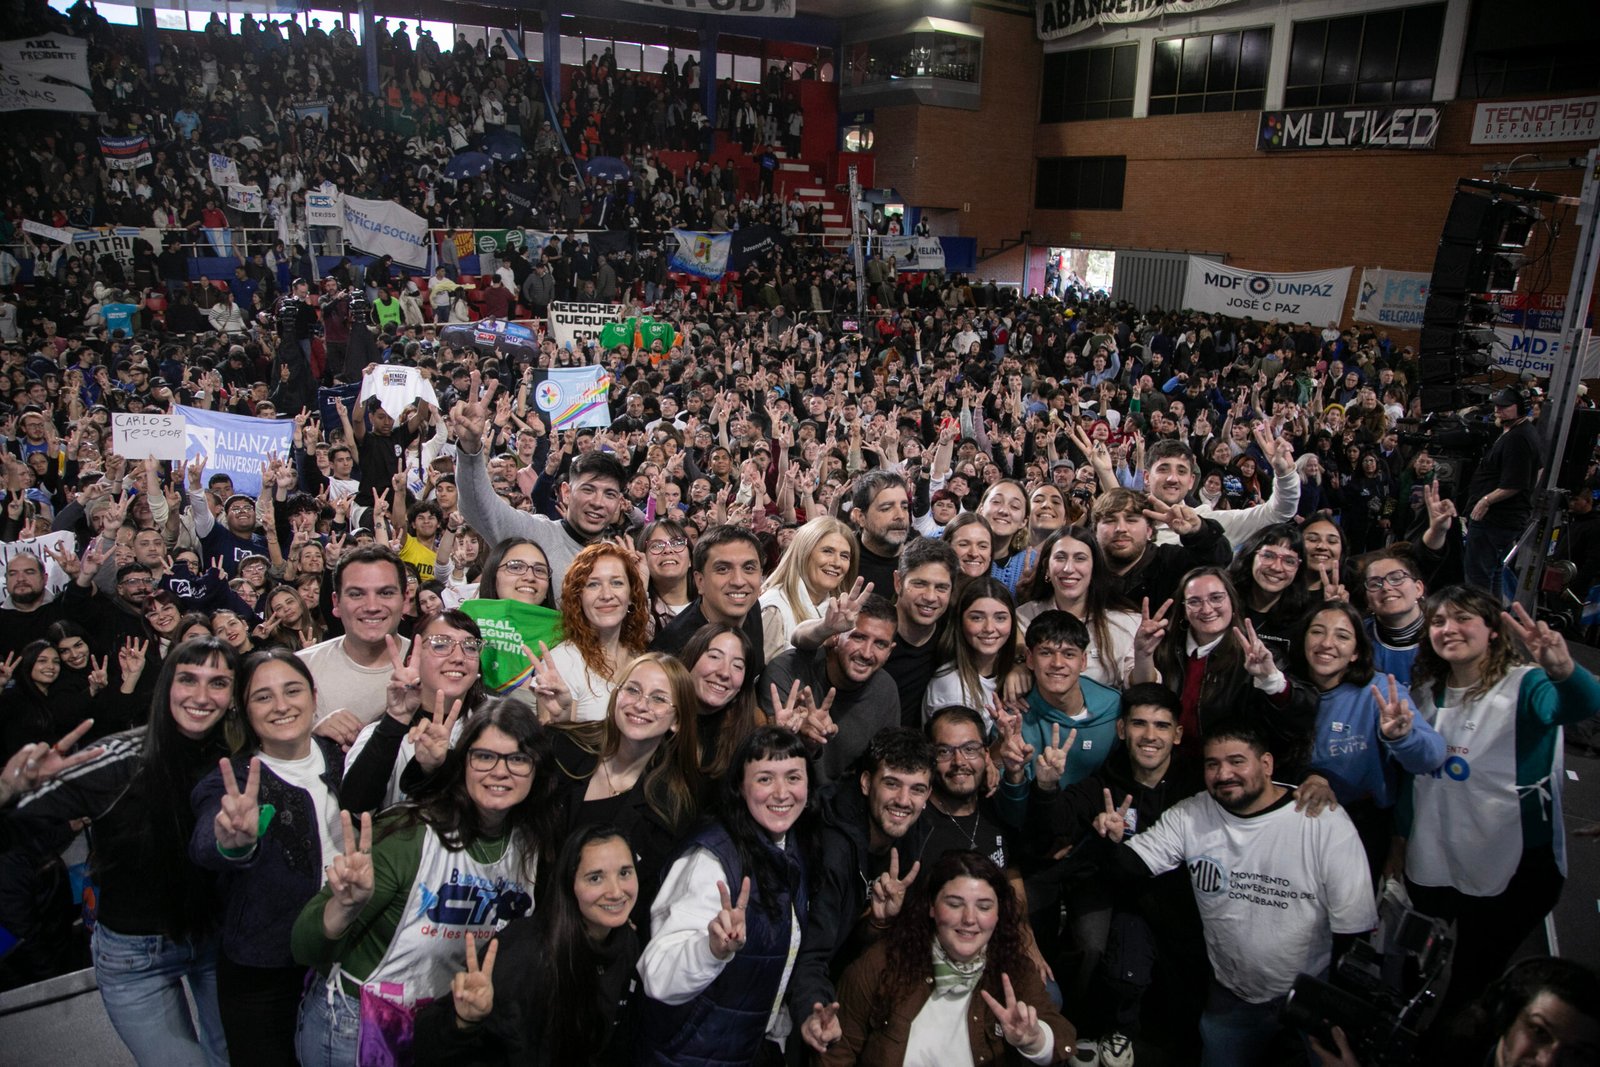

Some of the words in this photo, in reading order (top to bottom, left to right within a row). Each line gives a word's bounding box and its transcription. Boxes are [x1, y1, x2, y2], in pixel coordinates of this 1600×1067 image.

[26, 41, 60, 49] AXEL
[20, 51, 76, 60] PRESIDENTE
[1485, 101, 1598, 123] TECNOPISO
[1282, 107, 1440, 147] MULTILED
[1485, 118, 1594, 133] DEPORTIVO
[101, 229, 115, 237] LA
[383, 226, 424, 246] SOCIAL
[75, 236, 131, 254] PATRI
[1204, 272, 1243, 290] MDF
[1277, 282, 1333, 297] UNPAZ
[551, 303, 622, 314] NECOCHEA
[1227, 297, 1259, 309] JOSÉ
[1262, 301, 1272, 311] C
[1275, 302, 1301, 314] PAZ
[1541, 294, 1567, 308] FREN
[556, 314, 619, 326] QUEQUEN
[1379, 309, 1425, 324] BELGRAN
[1499, 357, 1554, 372] NECOCH
[115, 414, 171, 427] CARLOS
[216, 431, 277, 455] ALIANZA
[477, 618, 516, 633] EGAL,
[480, 628, 524, 645] EGURO,
[1189, 860, 1222, 893] MUC
[1230, 871, 1290, 887] MOVIMIENTO
[1229, 880, 1298, 899] UNIVERSITARIO
[1300, 892, 1317, 900] DEL
[1228, 892, 1289, 910] CONURBANO
[421, 925, 438, 937] de
[443, 928, 461, 939] les
